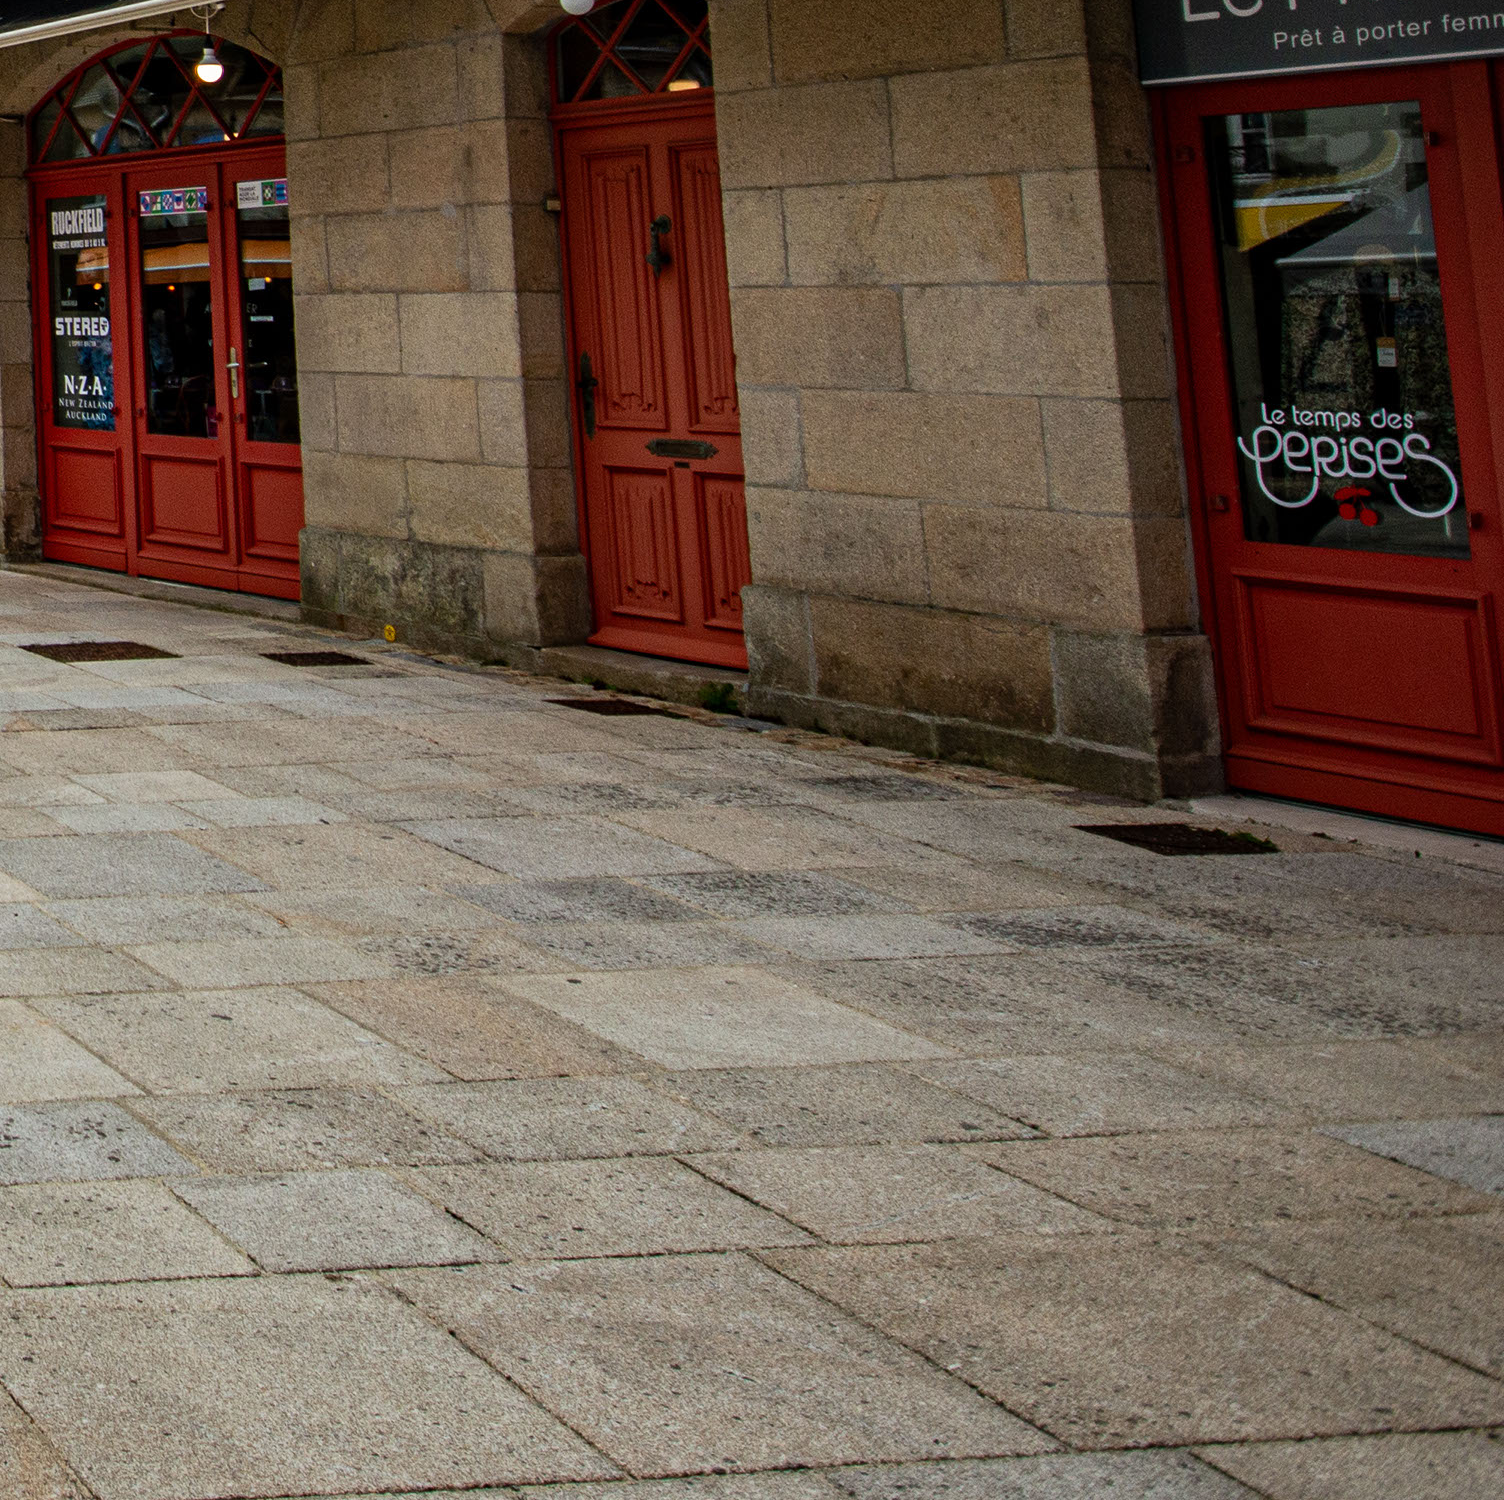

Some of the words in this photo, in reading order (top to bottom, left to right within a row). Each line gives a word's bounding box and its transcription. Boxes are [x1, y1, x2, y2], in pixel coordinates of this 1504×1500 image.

[1273, 29, 1323, 50] Prêt
[1332, 26, 1346, 45] à
[1356, 19, 1432, 46] porter
[51, 208, 104, 235] RUCKFIELD
[55, 317, 110, 337] STERED
[58, 397, 75, 408] NEW
[78, 398, 114, 410] ZEALAND
[65, 410, 107, 421] AUCKLAND
[1292, 404, 1362, 432] temps
[1370, 408, 1414, 430] des
